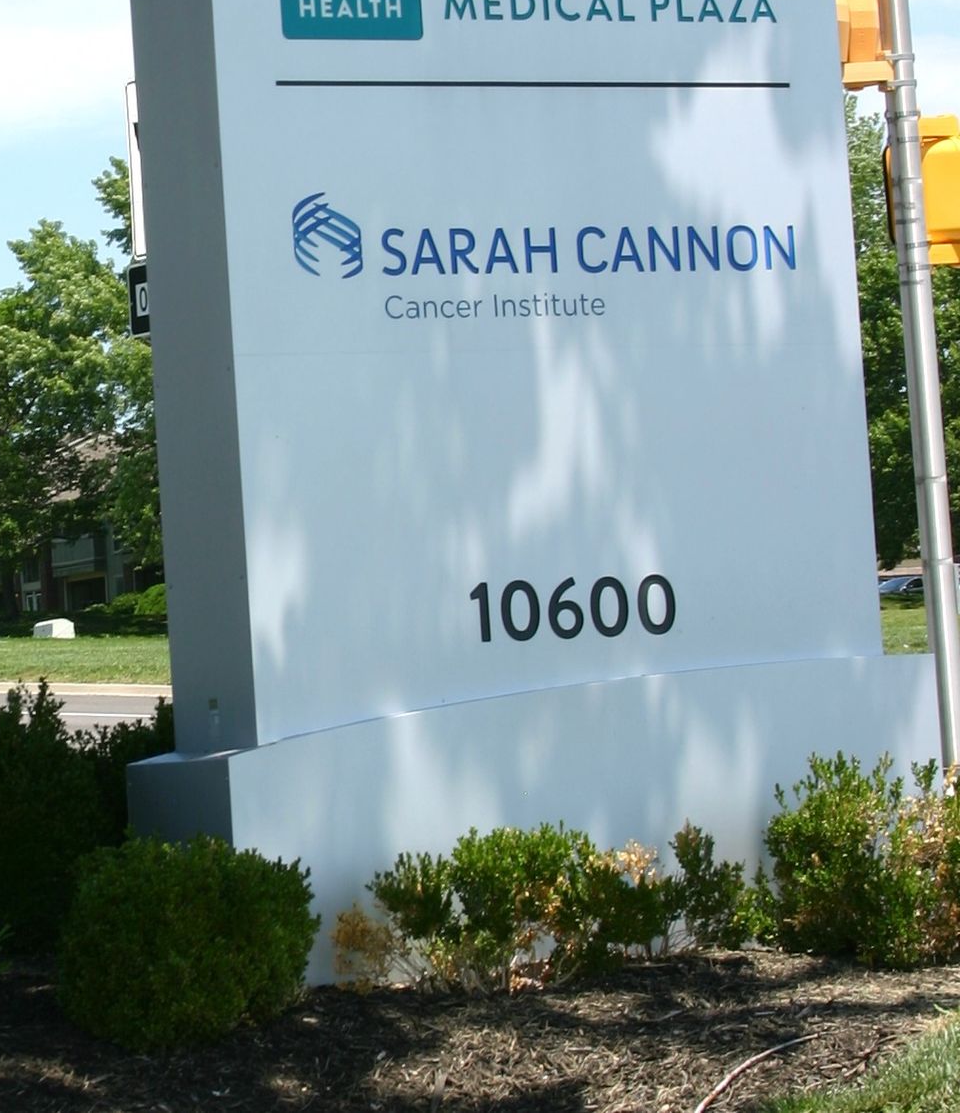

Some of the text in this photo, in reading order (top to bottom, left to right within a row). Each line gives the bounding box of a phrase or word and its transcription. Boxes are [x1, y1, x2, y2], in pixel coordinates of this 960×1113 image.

[381, 224, 797, 277] SARAH CANNON
[384, 293, 606, 320] Cancer Institute
[469, 574, 677, 643] 10600
